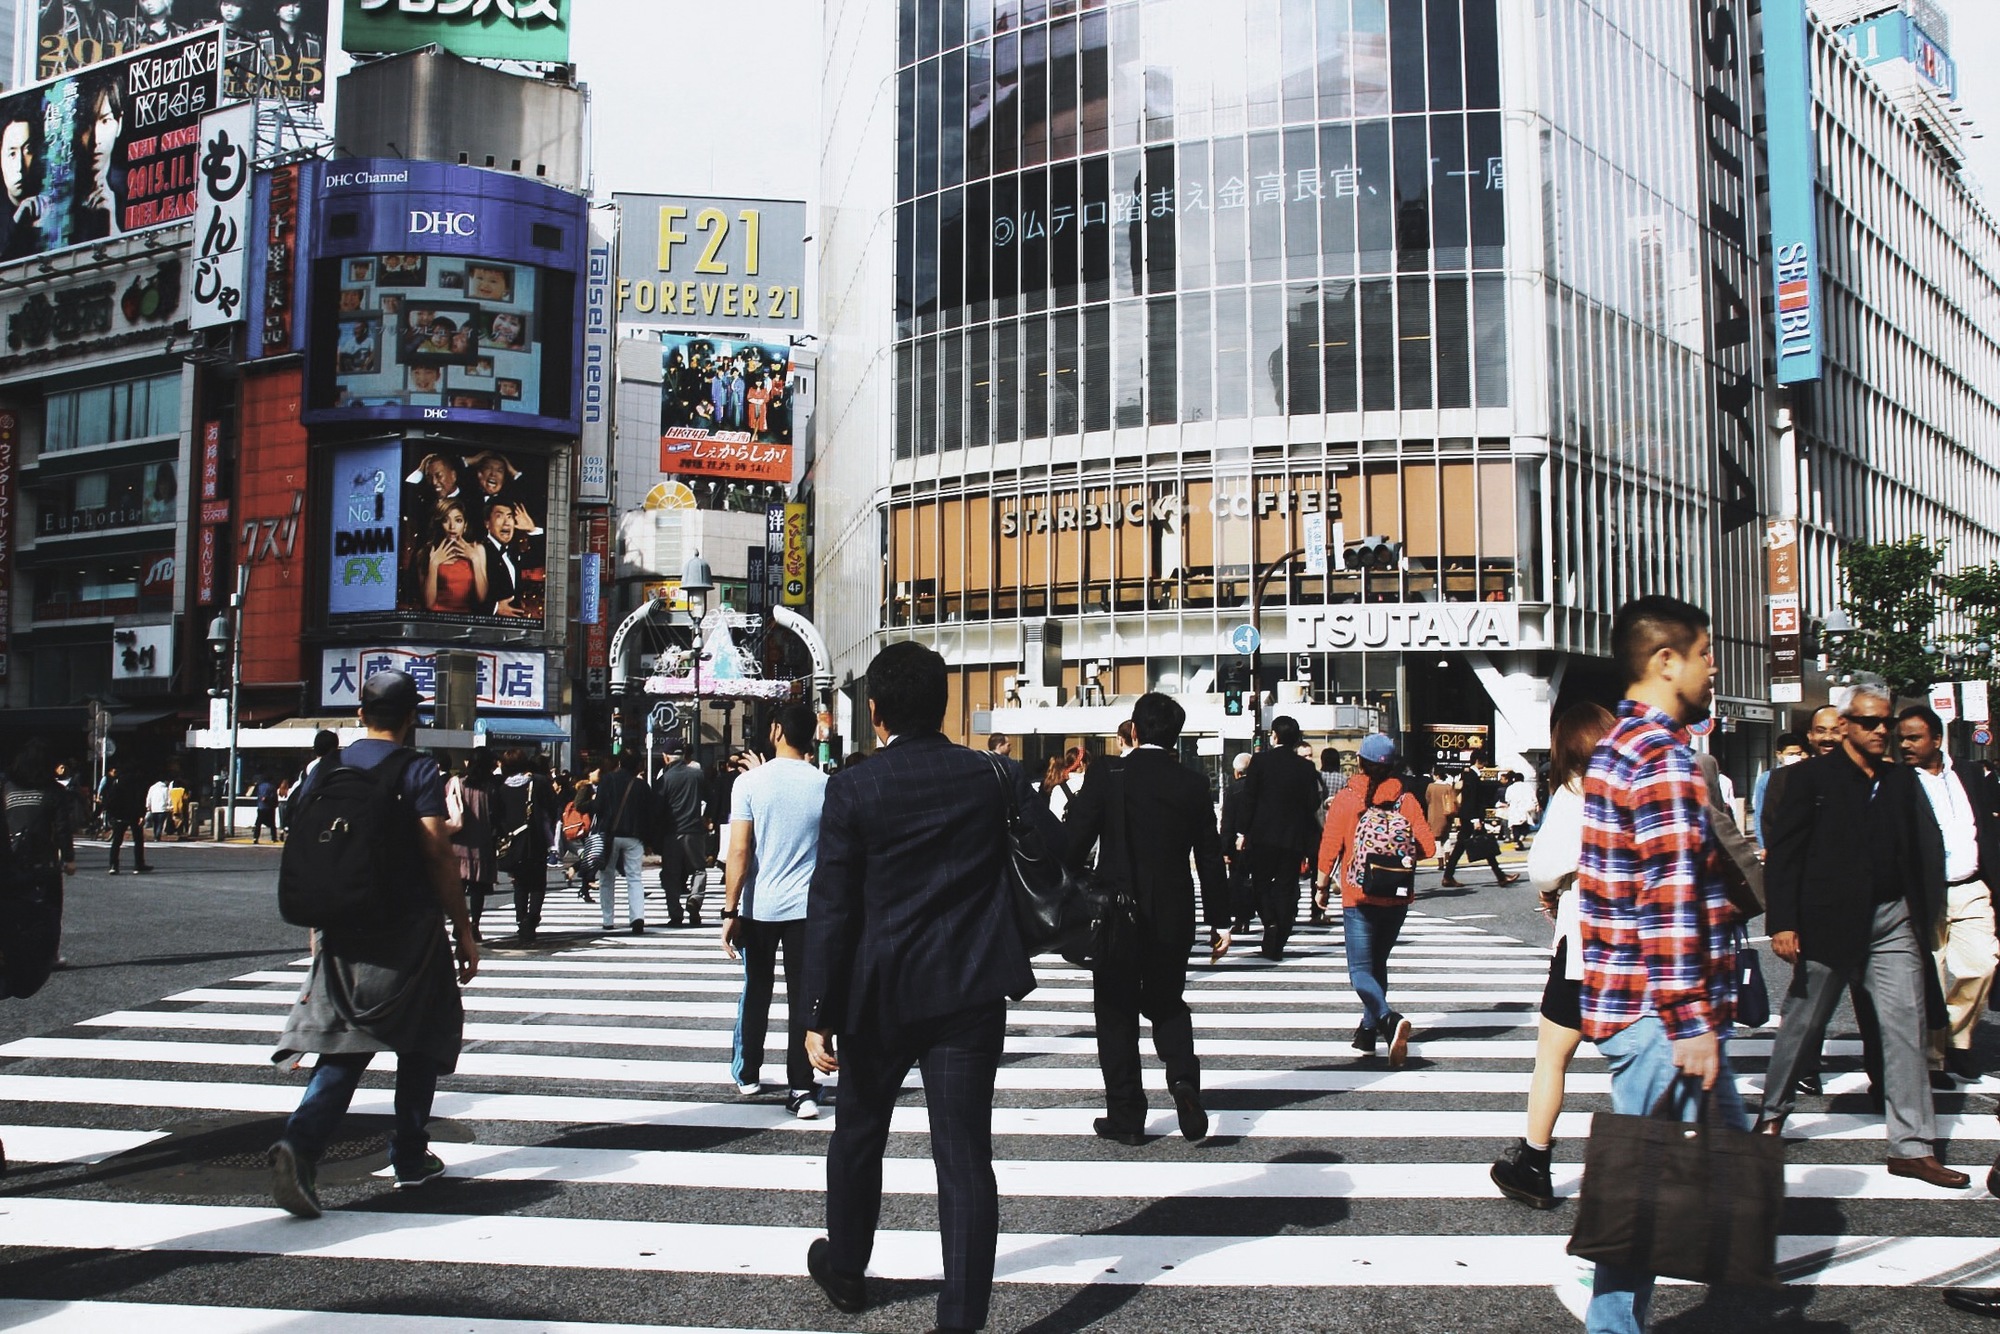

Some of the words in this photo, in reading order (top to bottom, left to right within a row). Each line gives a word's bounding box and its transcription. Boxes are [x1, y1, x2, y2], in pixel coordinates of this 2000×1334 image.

[129, 41, 217, 95] KinKi
[135, 82, 206, 128] Kids
[161, 124, 200, 152] SINGL
[127, 151, 199, 200] 2015.11.1
[326, 174, 353, 188] DHC
[355, 170, 408, 184] Channel
[125, 190, 199, 231] RELEAS
[193, 129, 247, 318] もんじゃ
[409, 211, 475, 236] DHC
[657, 205, 759, 276] F21
[617, 278, 759, 317] FOREVER
[767, 285, 800, 319] 21
[1777, 241, 1812, 362] SEIBU
[585, 345, 603, 423] neon
[424, 408, 448, 419] DHC
[667, 427, 709, 439] HKT48
[1209, 489, 1341, 517] COFFEE
[241, 490, 305, 563] クスリ
[335, 526, 394, 556] DMM
[343, 556, 385, 586] FX
[788, 582, 802, 593] 4F
[1298, 607, 1511, 649] TSUTAYA
[1774, 610, 1794, 629] 本
[1428, 734, 1466, 749] KB48
